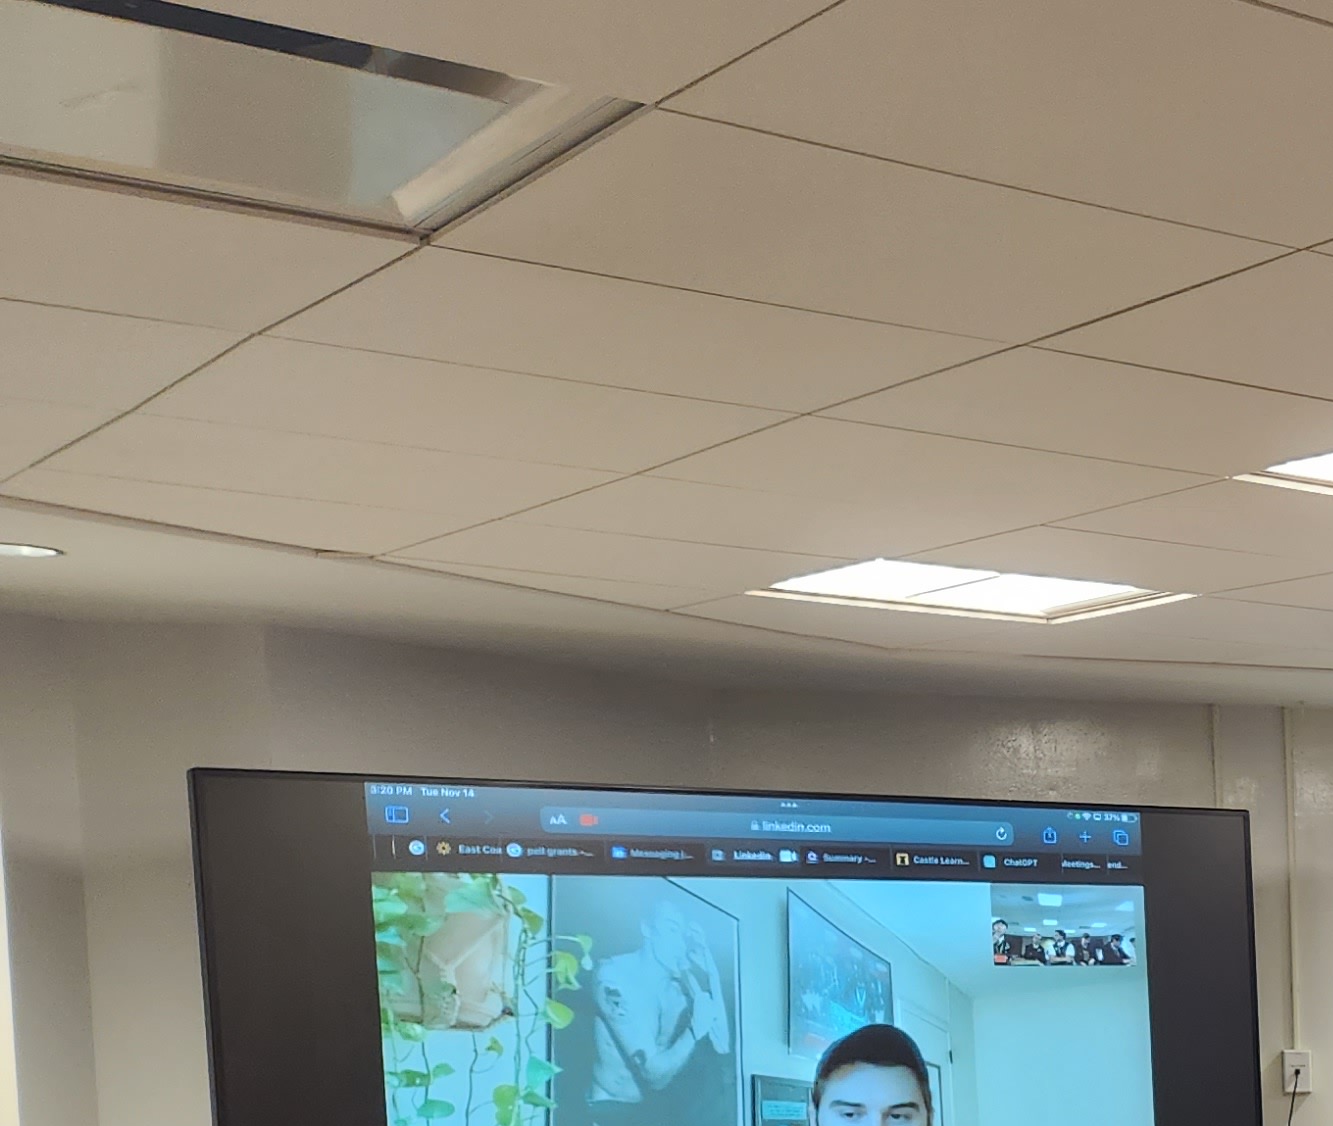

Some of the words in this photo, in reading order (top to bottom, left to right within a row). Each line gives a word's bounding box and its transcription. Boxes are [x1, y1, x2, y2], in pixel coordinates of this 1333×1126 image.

[396, 786, 413, 796] PM
[421, 787, 439, 796] Tue
[441, 788, 461, 797] Nov
[463, 789, 475, 798] 14
[762, 820, 832, 833] linkedin.com
[913, 855, 939, 865] Castle
[1004, 858, 1038, 867] ChatGPT
